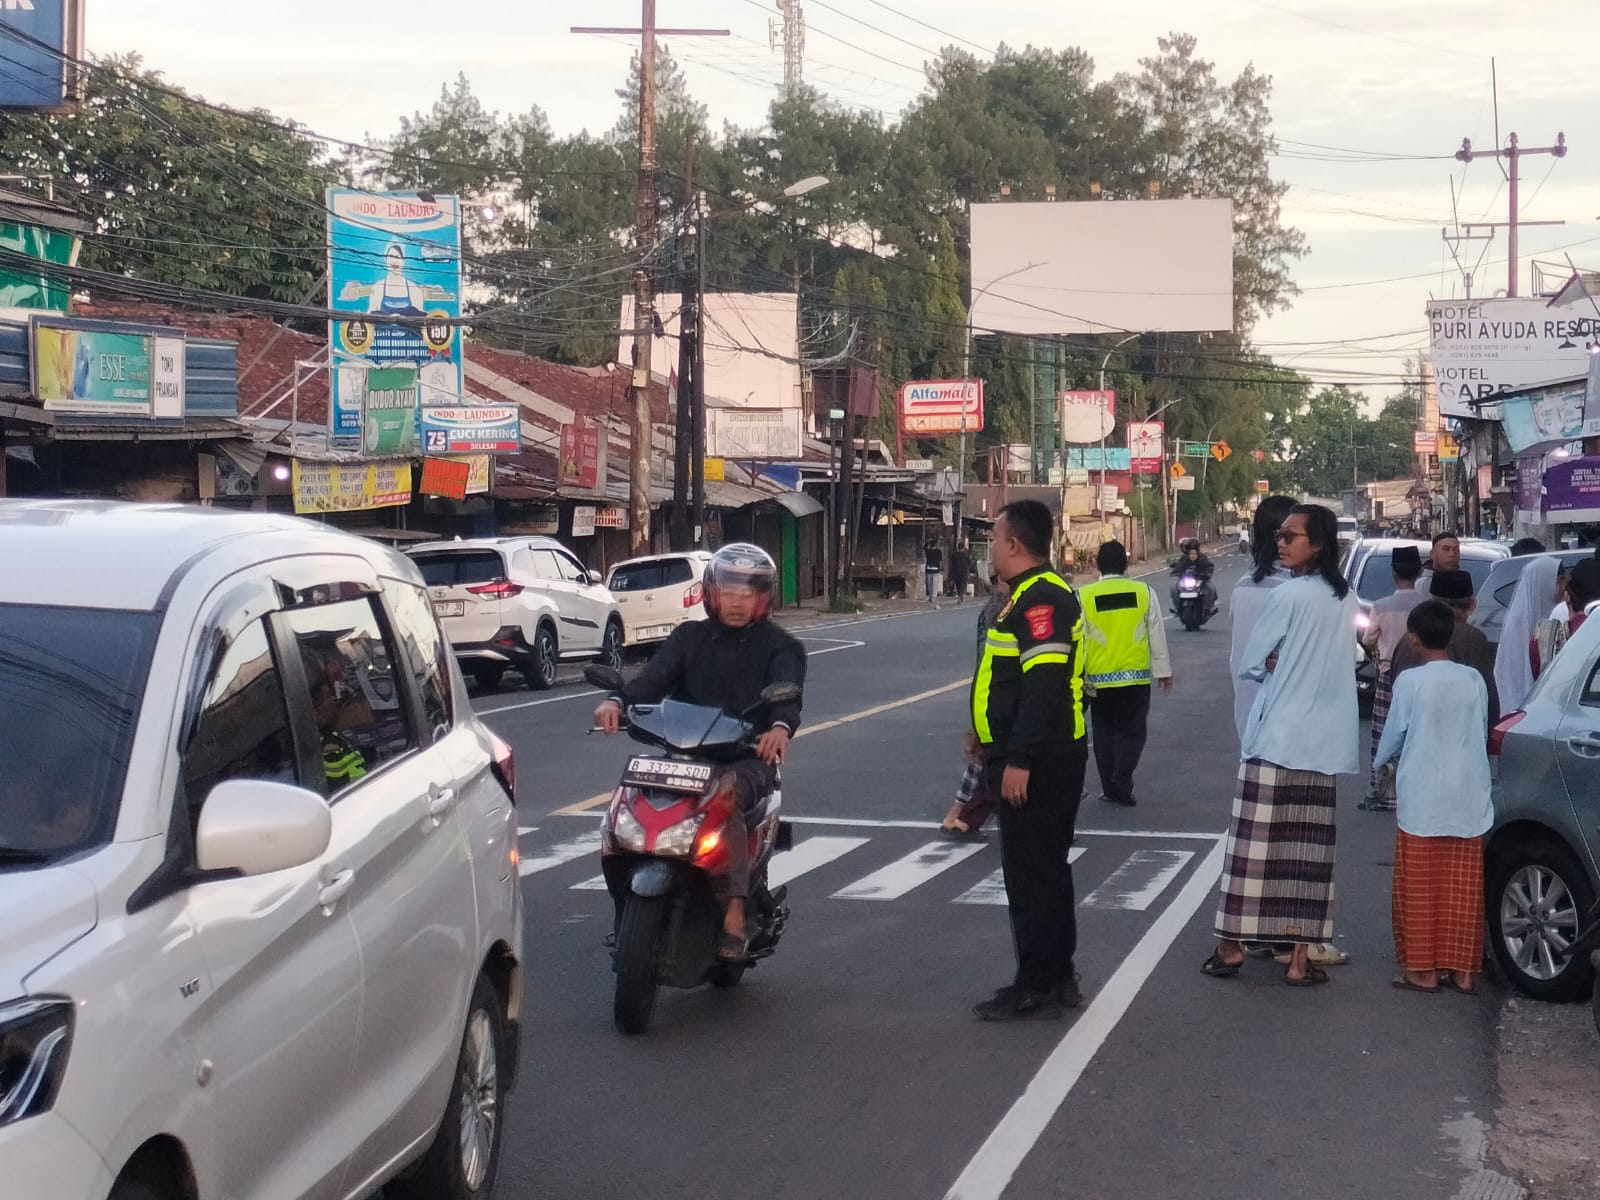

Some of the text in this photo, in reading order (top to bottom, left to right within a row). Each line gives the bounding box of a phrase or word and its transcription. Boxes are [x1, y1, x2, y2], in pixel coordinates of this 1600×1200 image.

[352, 202, 436, 217] INDO LAUNDRY
[1432, 307, 1487, 319] HOTEL
[1432, 321, 1472, 339] PURI
[1478, 320, 1537, 339] AYUDA
[100, 353, 126, 381] ESSE
[161, 356, 175, 373] TOKO
[1436, 368, 1489, 380] HOTEL
[155, 381, 179, 399] PRIANGAN
[395, 388, 416, 408] AYAM
[433, 410, 507, 420] INDO LAUNDRY
[427, 428, 518, 445] 75 CUCI KERING
[632, 760, 640, 771] B
